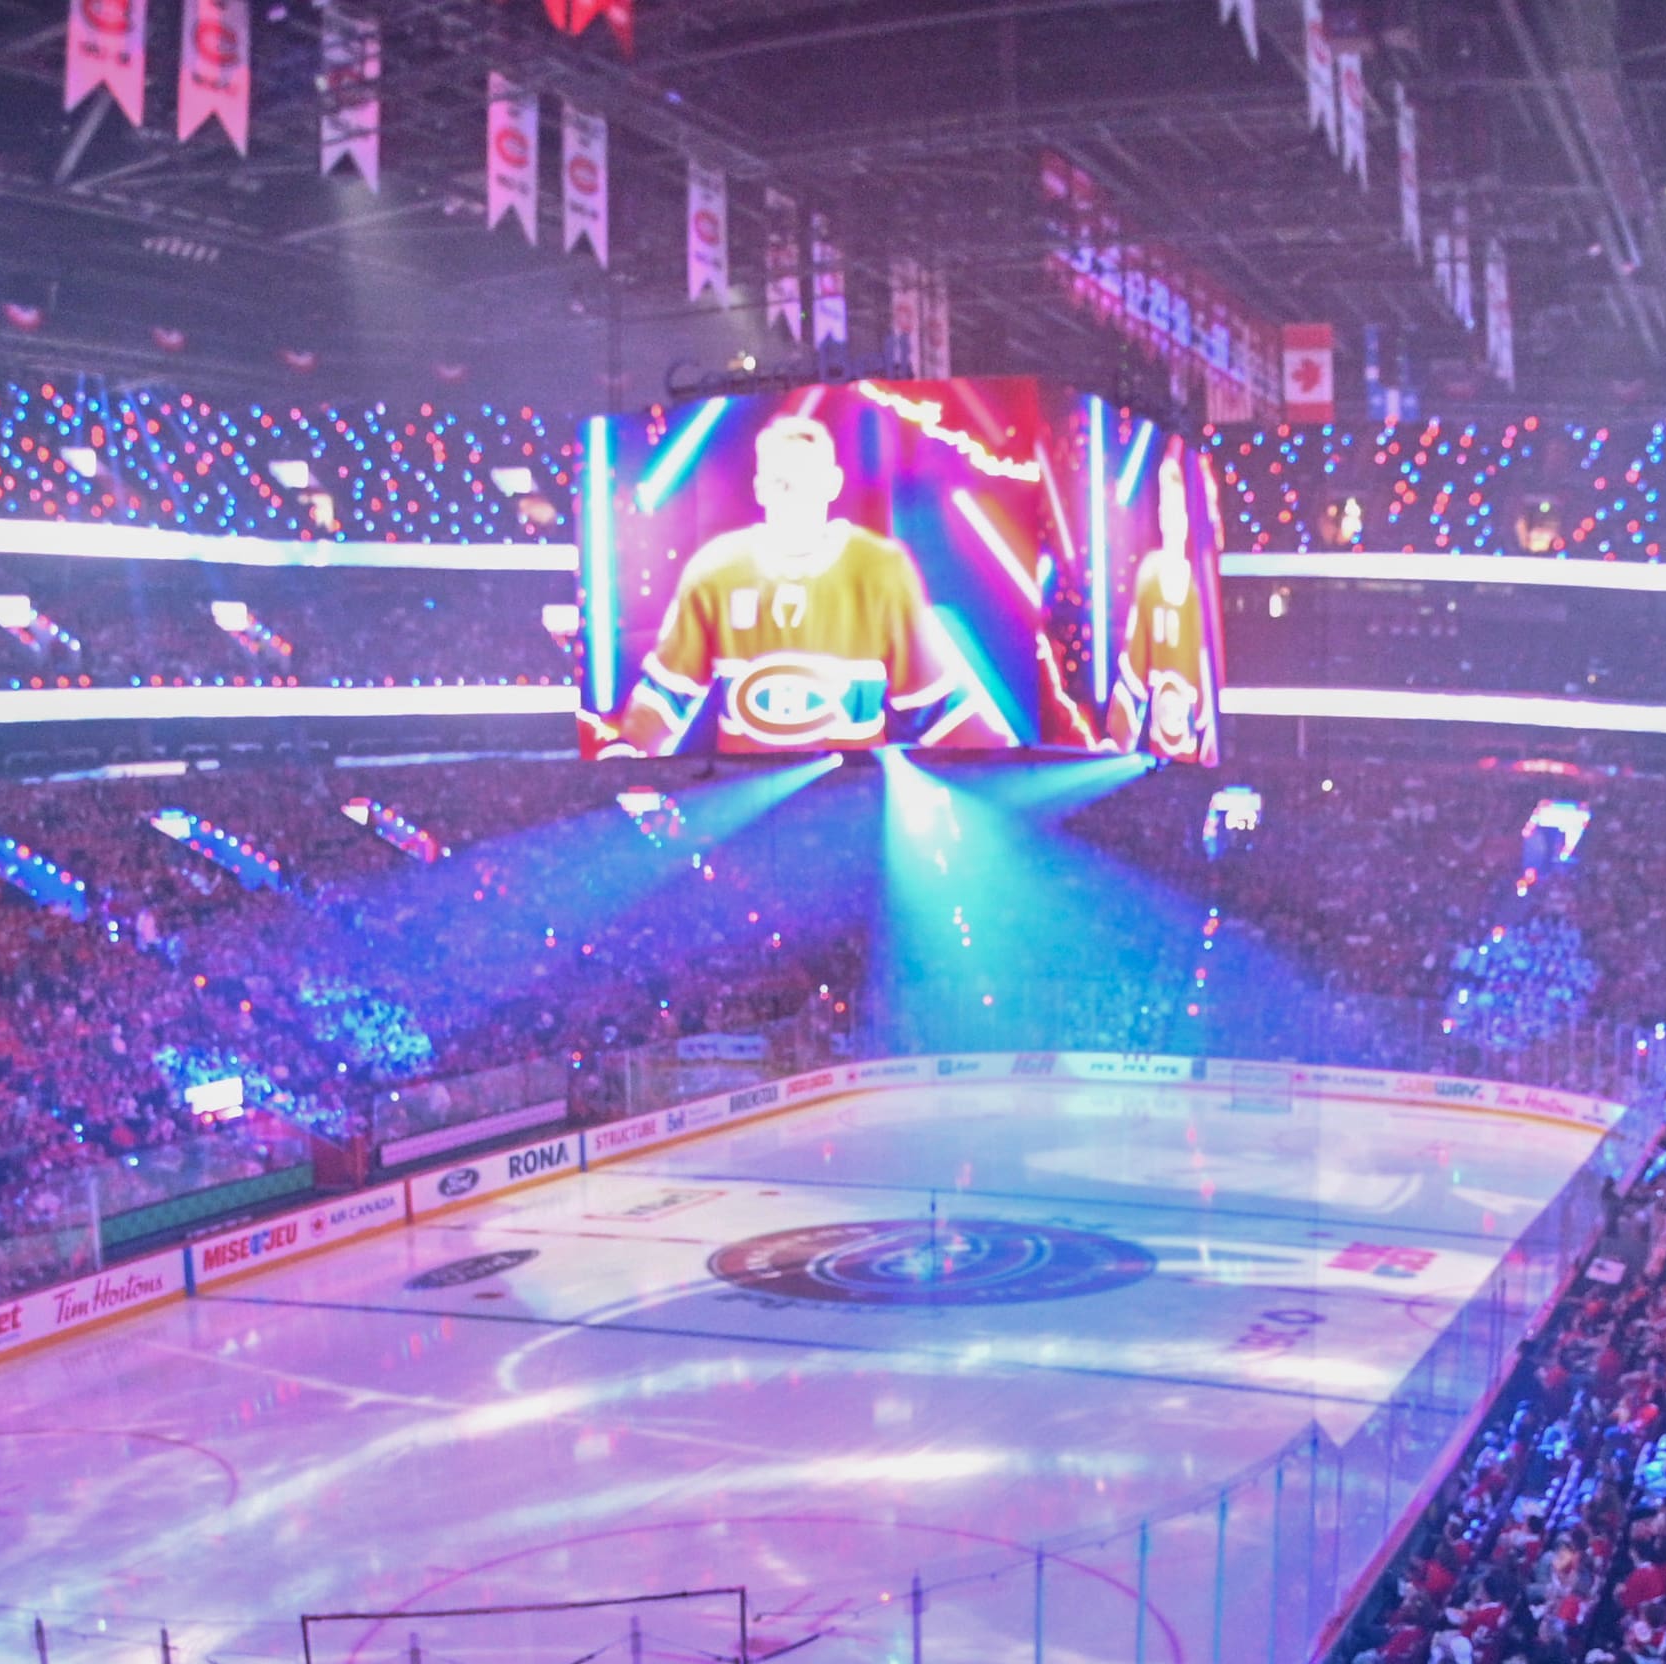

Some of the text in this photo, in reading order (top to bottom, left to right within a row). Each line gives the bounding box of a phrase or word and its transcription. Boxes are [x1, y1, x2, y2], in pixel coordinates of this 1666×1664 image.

[508, 1142, 569, 1179] RONA
[349, 1196, 396, 1221] CANADA
[54, 1274, 163, 1324] Tim Hortons
